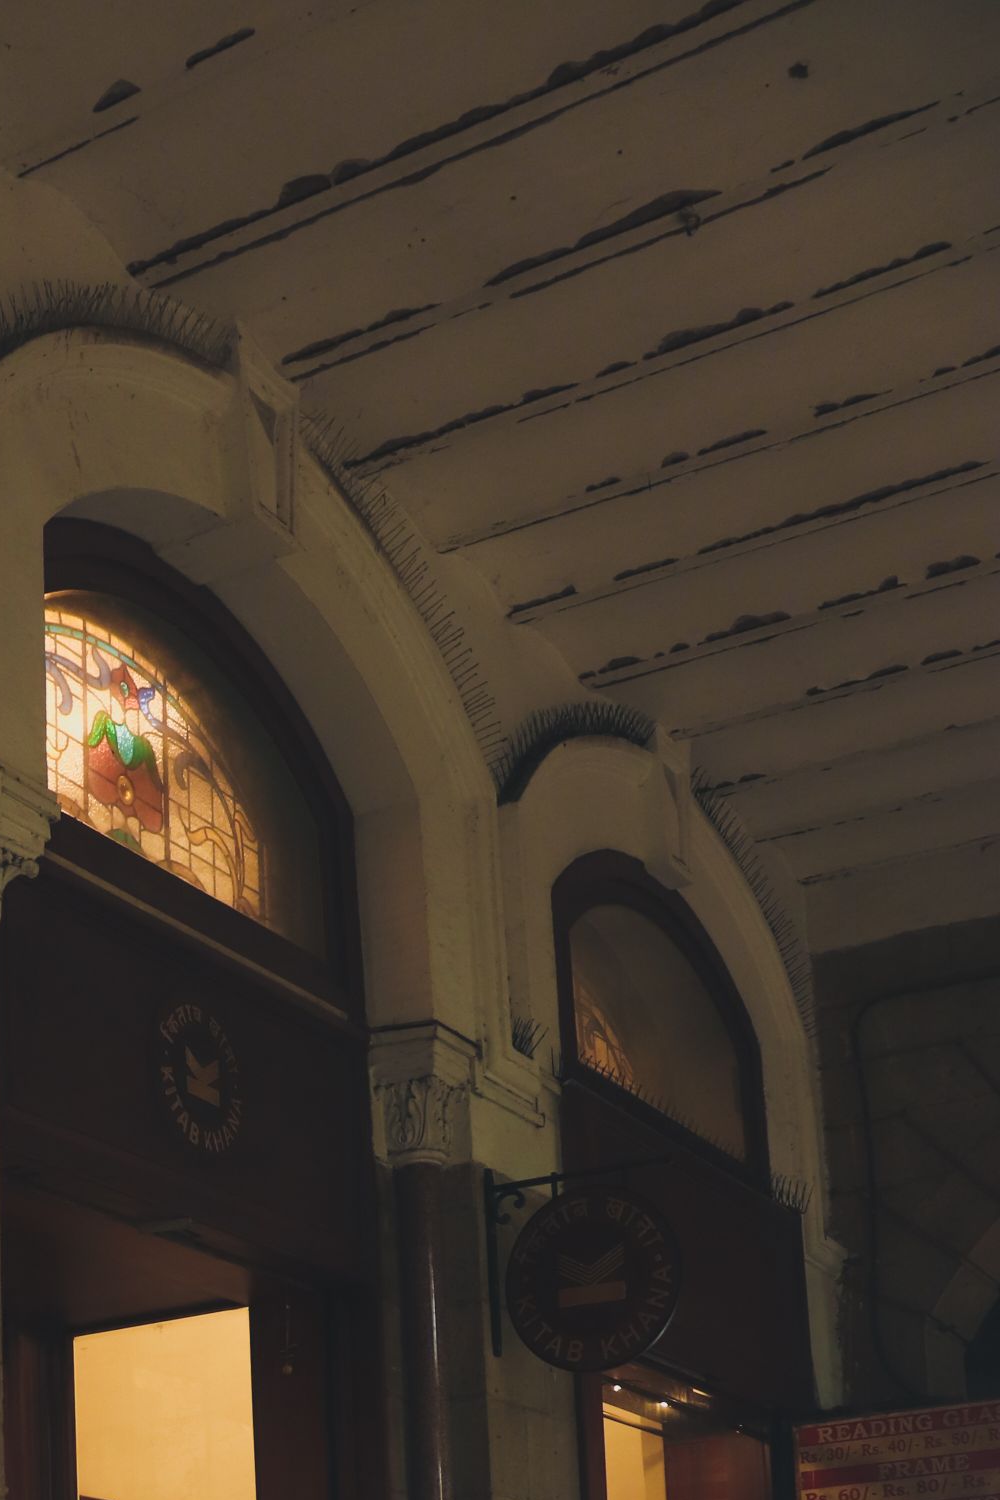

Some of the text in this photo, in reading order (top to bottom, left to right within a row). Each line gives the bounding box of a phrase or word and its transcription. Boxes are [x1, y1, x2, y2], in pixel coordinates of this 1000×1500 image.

[160, 1066, 242, 1152] KITAB KHANA
[514, 1264, 673, 1362] KITAB KHANA
[817, 1414, 934, 1444] READING
[862, 1444, 883, 1456] Rs.
[888, 1438, 920, 1454] 40/-
[924, 1435, 947, 1448] Rs.
[877, 1454, 968, 1480] FRAME
[883, 1484, 909, 1497] Rs.
[962, 1474, 991, 1488] Rs.
